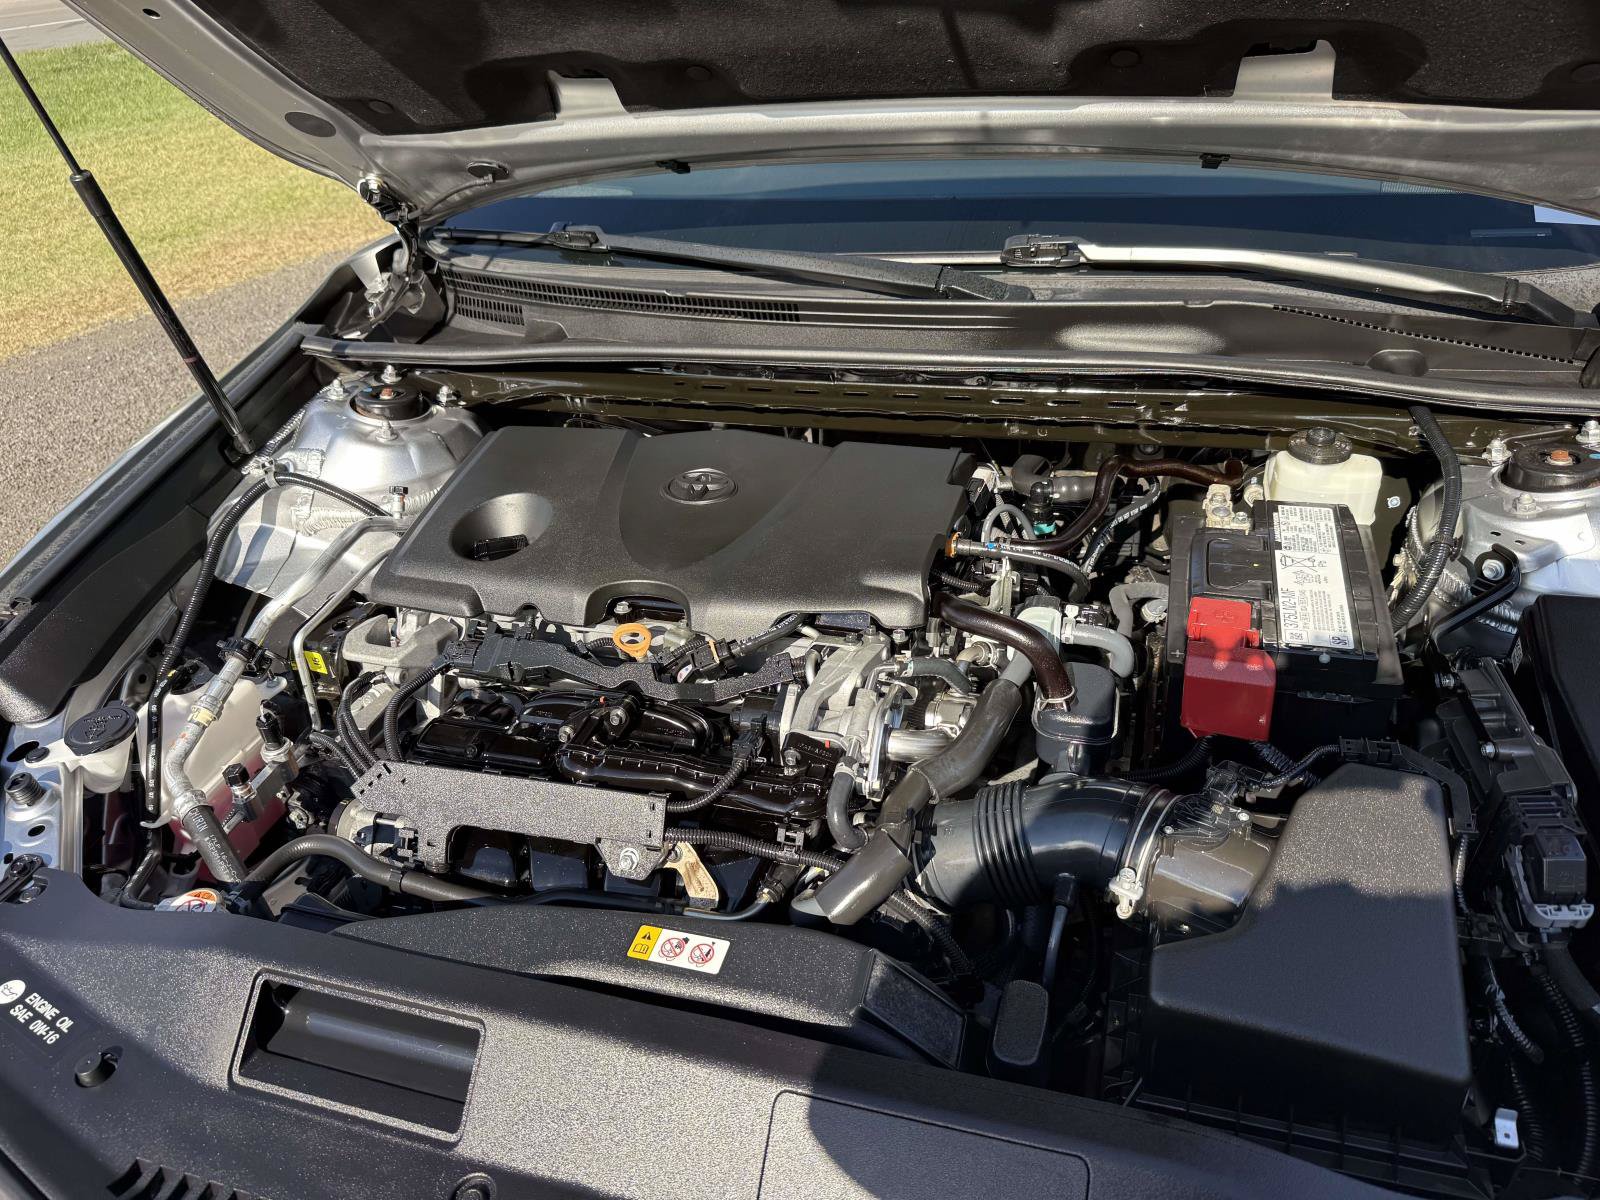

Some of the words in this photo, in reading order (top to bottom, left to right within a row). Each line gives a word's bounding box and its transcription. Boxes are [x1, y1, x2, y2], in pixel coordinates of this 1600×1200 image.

[9, 1004, 34, 1023] SAE
[29, 1019, 60, 1044] 0W-16
[25, 992, 60, 1020] ENGINE
[56, 1016, 74, 1033] OIL
